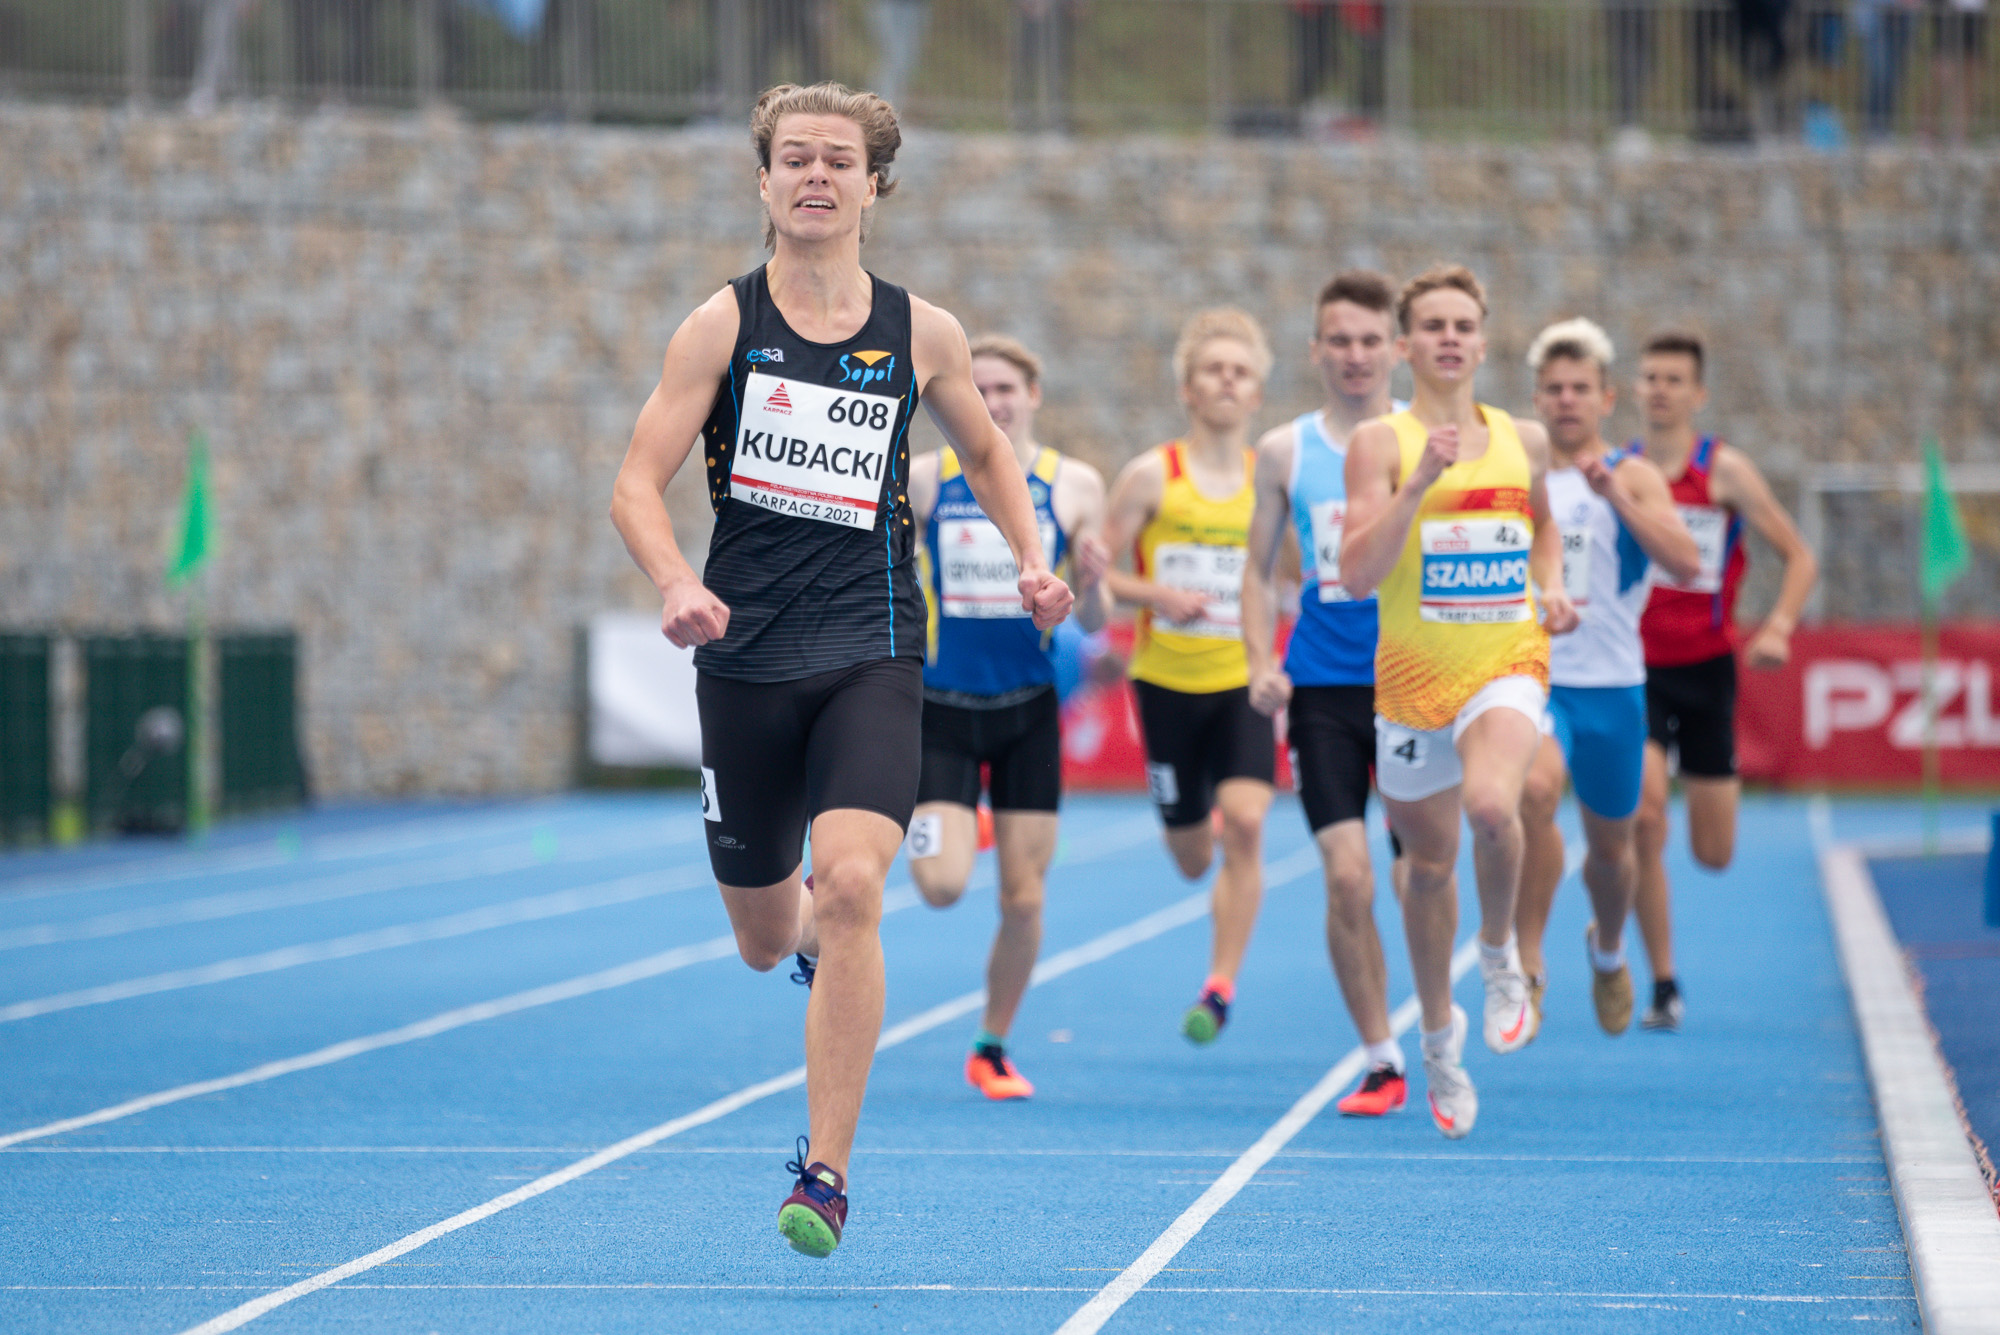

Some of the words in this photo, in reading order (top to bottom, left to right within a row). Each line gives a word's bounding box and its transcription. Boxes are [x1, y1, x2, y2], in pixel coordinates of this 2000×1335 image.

[747, 348, 785, 363] esa
[839, 353, 896, 392] Sopot
[762, 405, 793, 416] KARPACZ
[827, 396, 889, 431] 608
[740, 429, 884, 482] KUBACKI
[750, 491, 820, 517] KARPACZ
[823, 506, 859, 525] 2021
[1393, 738, 1419, 765] 4
